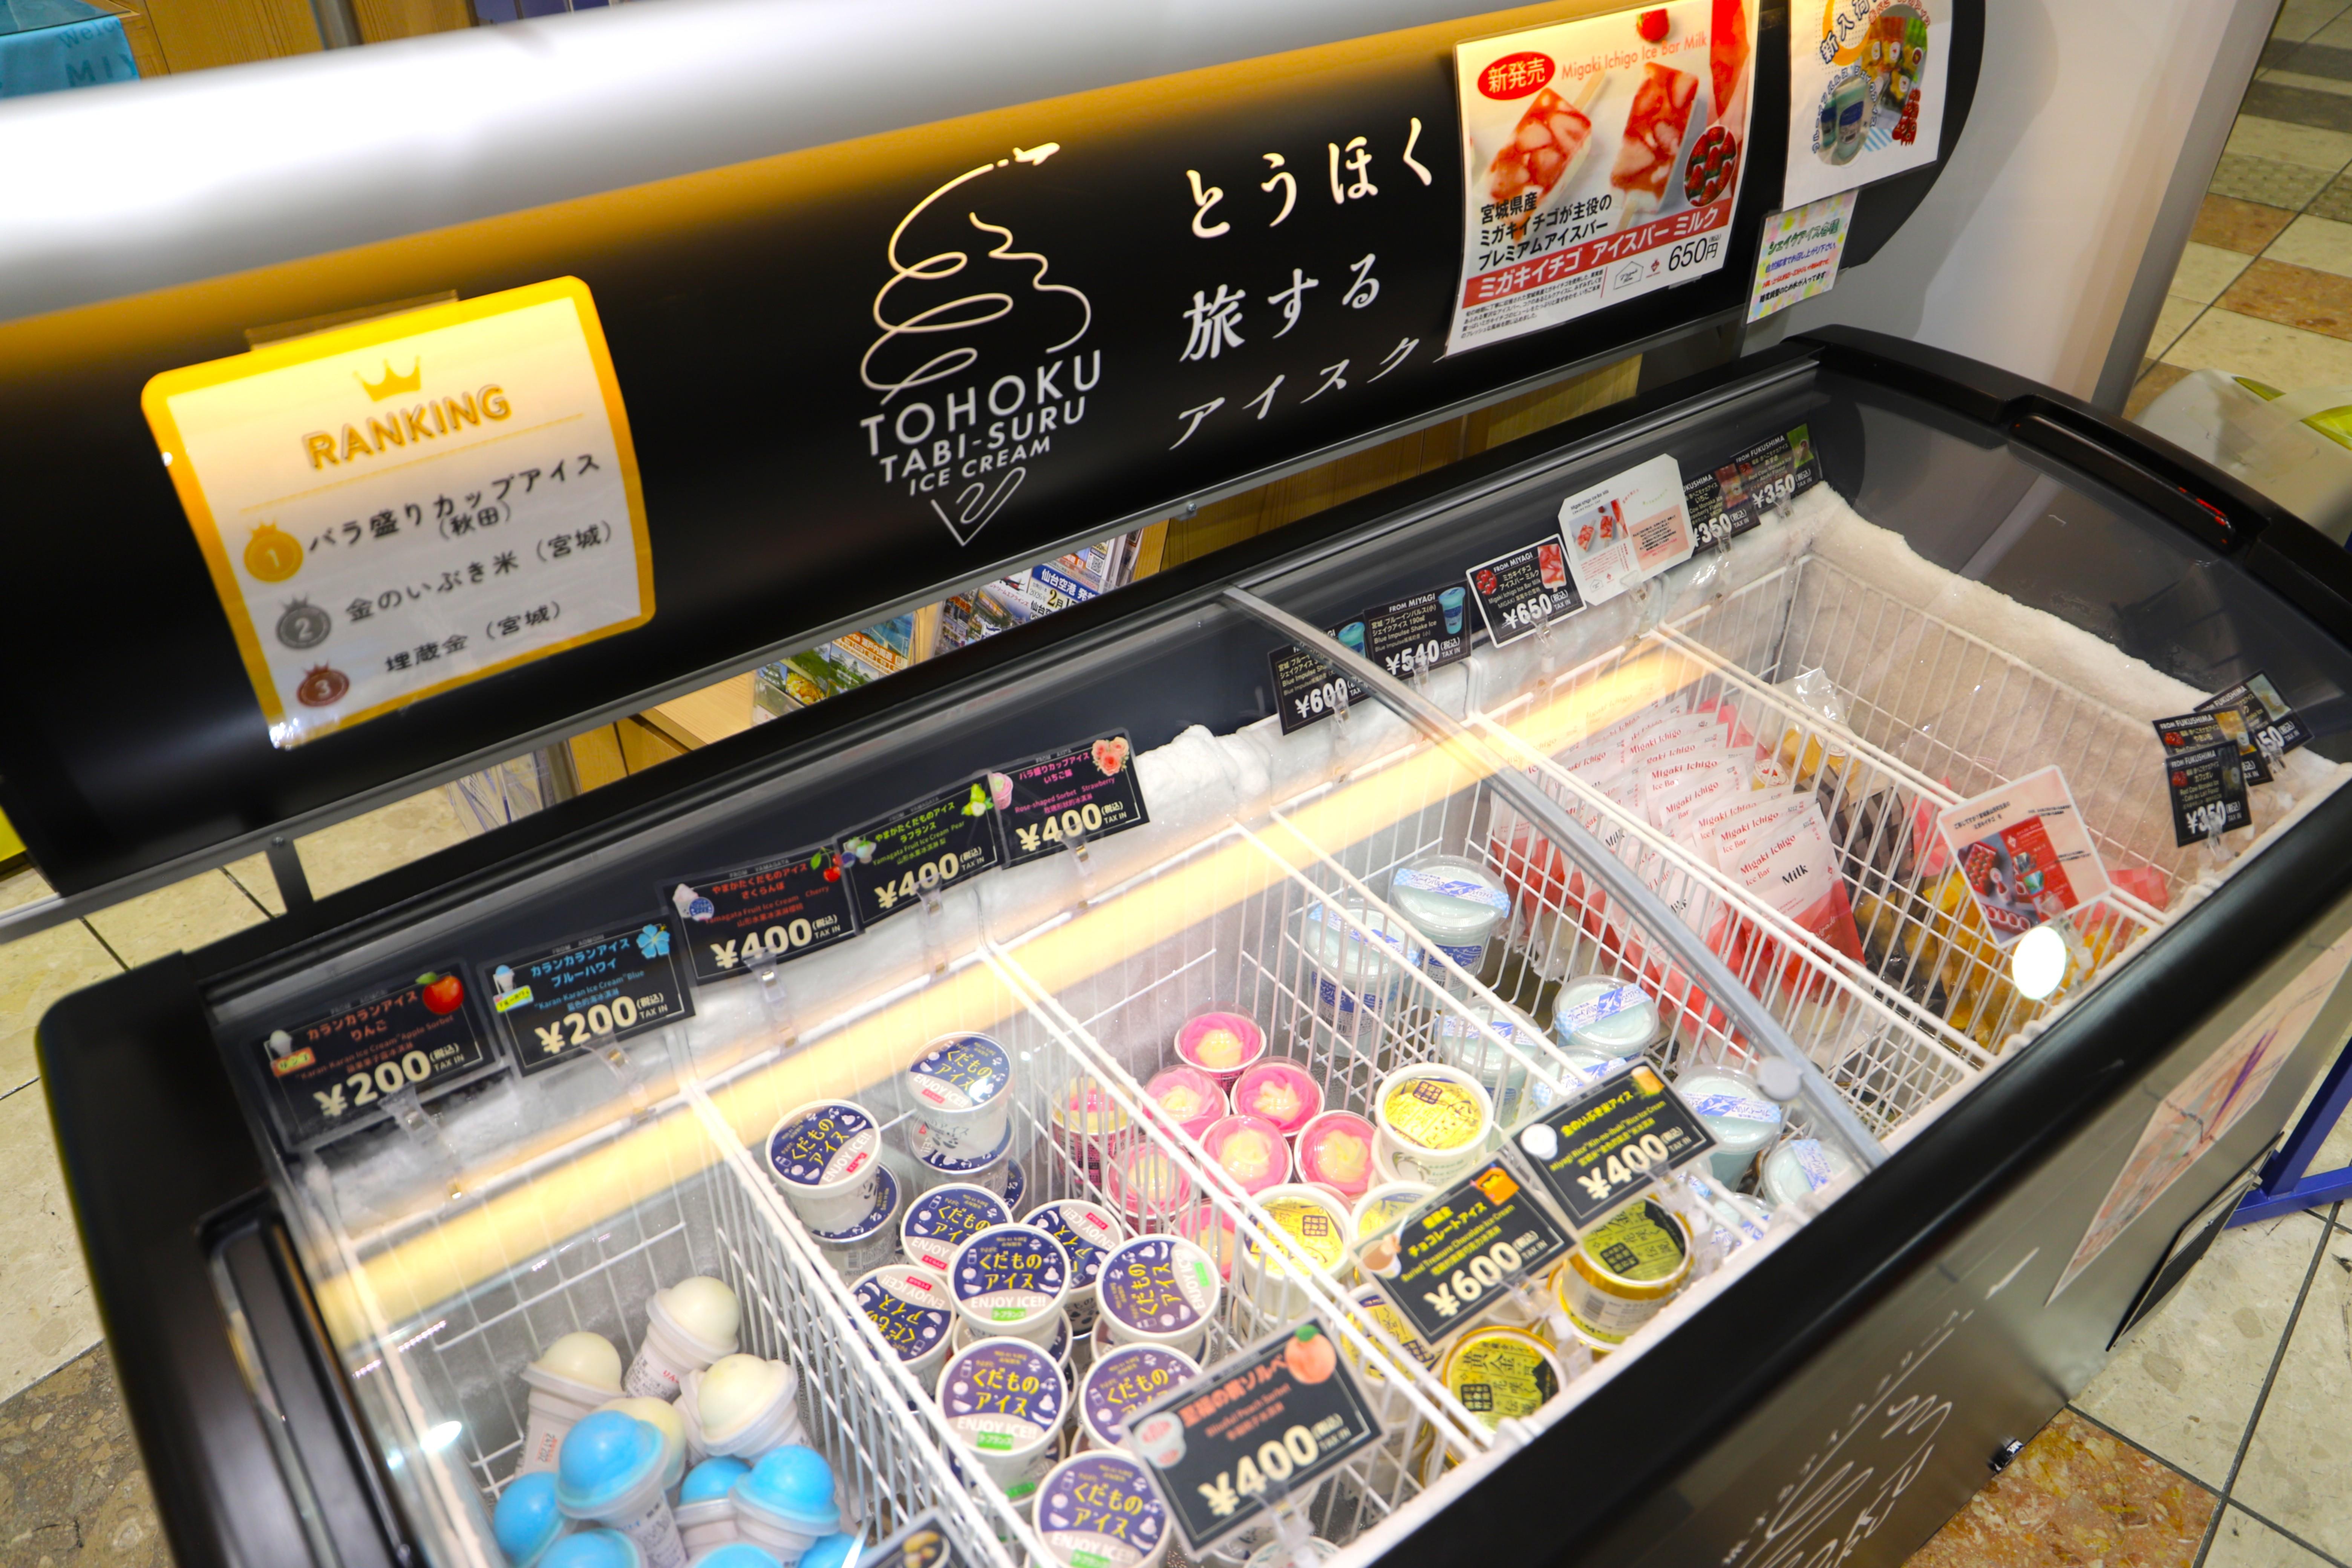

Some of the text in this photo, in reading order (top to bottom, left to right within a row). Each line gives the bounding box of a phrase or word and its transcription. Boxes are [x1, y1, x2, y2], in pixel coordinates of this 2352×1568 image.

[1820, 0, 1877, 64] 新入荷
[1562, 31, 1707, 80] Migaki Ichigo Ice Bar Milk
[1487, 58, 1545, 94] 新発売
[1186, 117, 1432, 238] とうほく
[1481, 191, 1537, 224] 宮城県産
[1481, 194, 1612, 246] ミガキイチゴが主役の
[1479, 219, 1608, 271] プレミアムアイスバー
[1479, 207, 1718, 298] ミガキイチゴ アイスバー ミルク
[1669, 238, 1718, 271] 650円
[1181, 253, 1380, 362] 旅する
[860, 350, 1101, 458] TOHOKU
[1170, 337, 1447, 450] アイスク
[302, 384, 513, 470] RANKING
[880, 397, 1086, 484] TABI-SURU
[1736, 435, 1785, 463] FROM FUKUSHIMA
[910, 436, 1050, 496] ICE CREAM
[1683, 474, 1713, 492] UKUSHIMA
[1752, 474, 1795, 508] ¥350
[309, 455, 600, 552] バラ盛りカップアイス
[1493, 552, 1533, 573] FROM MIYAGI
[1502, 565, 1531, 581] ミガキイチゴ
[1041, 568, 1077, 596] 仙台空港
[1499, 570, 1539, 591] アイスバー ミルク
[1389, 593, 1436, 613] FROM MIYAGI
[1488, 593, 1503, 604] Migaki
[1502, 593, 1552, 629] ¥650
[1372, 620, 1407, 636] シェイクアイス
[1374, 635, 1387, 644] Blue
[1388, 628, 1410, 640] Impulse
[1411, 623, 1427, 633] Shake
[1280, 660, 1313, 679] シェイクアイス
[1385, 639, 1439, 675] ¥540
[1282, 678, 1294, 687] Blue
[1295, 668, 1315, 681] Impulse
[1295, 678, 1348, 718] ¥600
[2176, 714, 2214, 726] FUKUSHIMA
[1630, 738, 1657, 755] Migaki
[2185, 750, 2216, 764] FUKUSHIMA
[1019, 752, 1090, 780] バラ盛りカップアイス
[1652, 760, 1718, 779] Migaki Ichigo
[1015, 777, 1115, 813] Rose-shaped Sorbet Strawberry
[1666, 781, 1719, 815] Migaki Ichigo
[875, 801, 956, 843] やまがたくだものアイス
[900, 822, 937, 843] ラフランス
[1016, 803, 1102, 851] ¥400
[1104, 815, 1117, 824] TAX
[1698, 811, 1727, 828] Migaki
[1721, 812, 1779, 841] Migaki Ichigo
[873, 848, 903, 865] Yamagata
[904, 840, 919, 852] Fruit
[920, 837, 928, 846] Ice
[929, 827, 949, 841] Cream
[951, 821, 965, 833] Pear
[1723, 838, 1747, 853] Ice Bar
[1740, 835, 1796, 875] Migaki Ichigo
[712, 863, 808, 895] やまがたくだものアイス
[961, 856, 985, 871] TAX IN
[1746, 866, 1770, 886] Ice Bar
[1782, 864, 1808, 885] Milk
[741, 882, 785, 900] さくらんぼ
[874, 853, 959, 909] ¥400
[743, 905, 761, 916] Fruit
[763, 901, 773, 911] Ice
[774, 895, 799, 908] Cream
[805, 886, 830, 898] Cherry
[710, 919, 812, 969] ¥400
[814, 925, 841, 939] TAX IN
[531, 938, 630, 977] カランカランアイス
[551, 958, 616, 988] ブルーハワイ
[586, 985, 597, 996] Ice
[307, 991, 418, 1040] カランカランアイス
[534, 996, 637, 1054] ¥200
[640, 1004, 668, 1019] TAX IN
[351, 1021, 387, 1041] りんご
[351, 1048, 368, 1061] Ice
[426, 1015, 453, 1031] Sorbet
[433, 1054, 465, 1072] TAX IN
[934, 1063, 976, 1091] アイス
[947, 1050, 992, 1079] くだもの
[313, 1050, 431, 1117] ¥200
[914, 1073, 947, 1095] ENJOY
[792, 1119, 834, 1160] くだもの
[809, 1131, 850, 1166] アイス
[822, 1149, 853, 1182] ENJOY
[1577, 1133, 1668, 1200] ¥400
[938, 1205, 991, 1231] くだもの
[1408, 1202, 1487, 1257] チョコレートアイス
[911, 1237, 949, 1259] ENJOY
[979, 1251, 1042, 1270] くだもの
[985, 1273, 1034, 1290] アイス
[1128, 1263, 1158, 1315] くだもの
[1152, 1263, 1181, 1306] アイス
[1423, 1242, 1522, 1317] ¥600
[971, 1297, 1015, 1308] ENJOY
[972, 1367, 1040, 1394] くだもの
[1107, 1368, 1168, 1404] くだもの
[975, 1391, 1027, 1417] アイス
[957, 1417, 1002, 1433] ENJOY
[1197, 1425, 1318, 1516] ¥400
